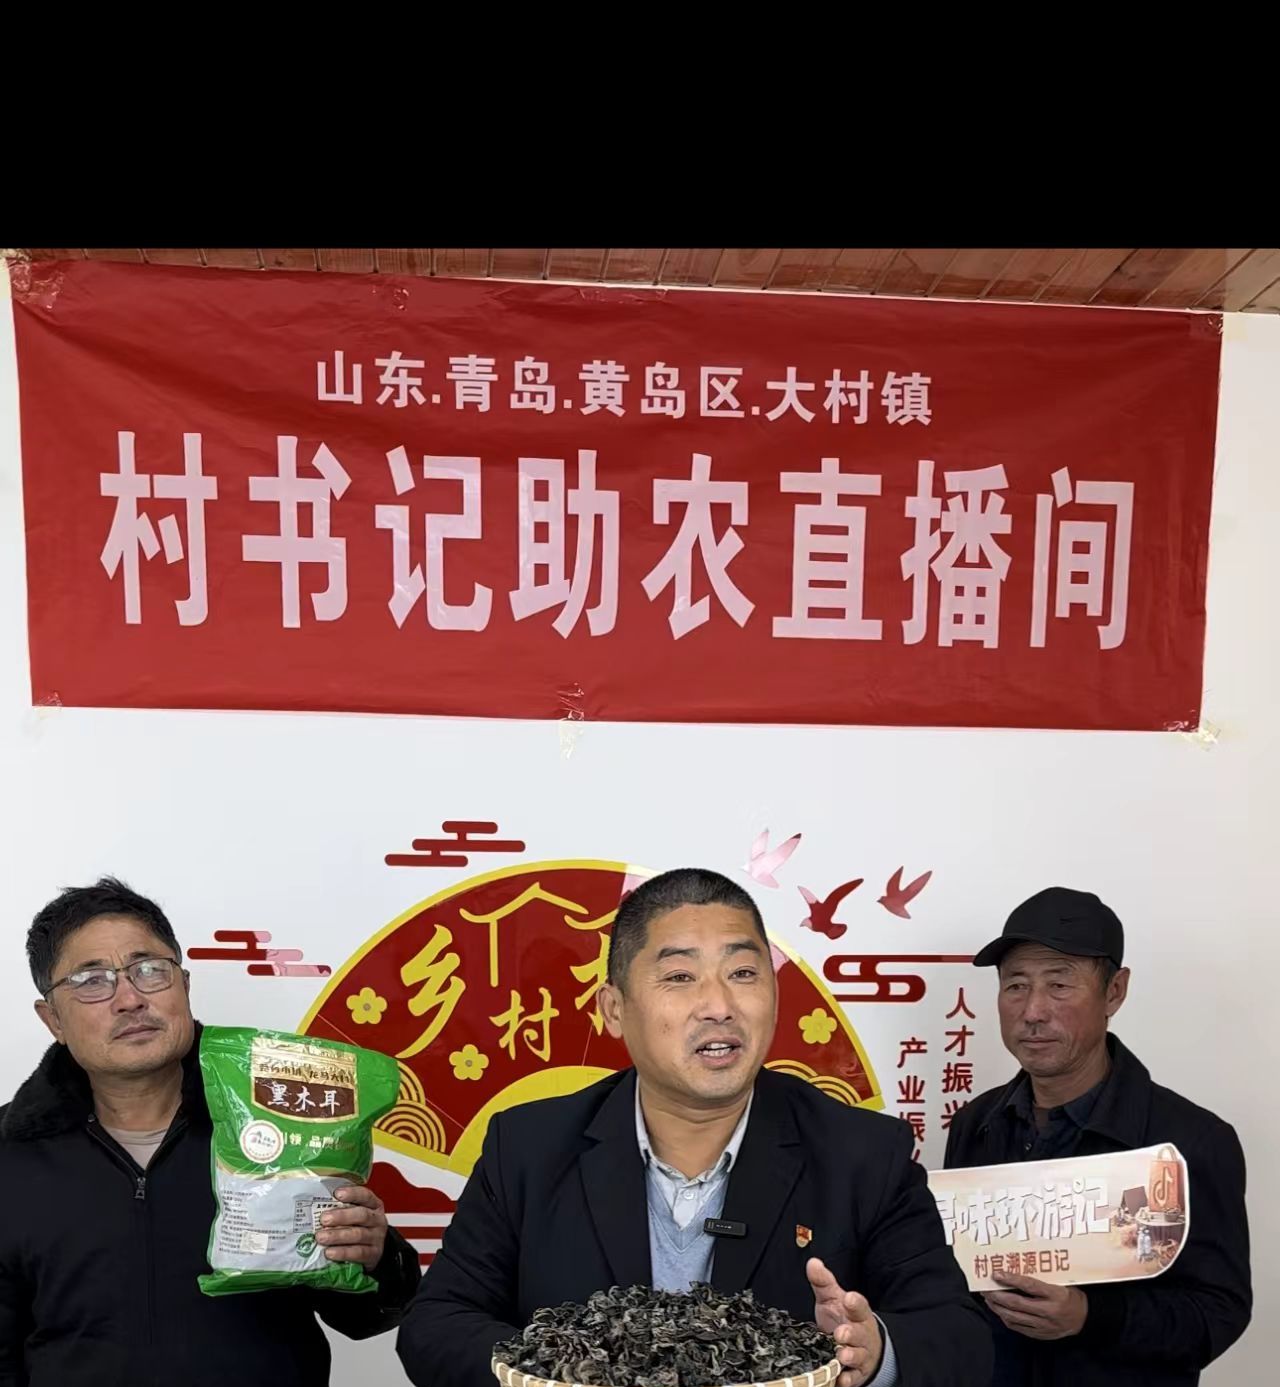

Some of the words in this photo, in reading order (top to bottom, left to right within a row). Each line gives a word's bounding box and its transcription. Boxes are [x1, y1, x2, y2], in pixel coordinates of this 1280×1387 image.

[316, 350, 934, 428] 山东.青岛.黄岛区.大村镇
[98, 431, 1135, 650] 村书记助农直播间
[266, 1080, 341, 1116] 黑木耳
[896, 1037, 928, 1162] 产业振
[974, 1249, 1070, 1279] 村官溯源日记
